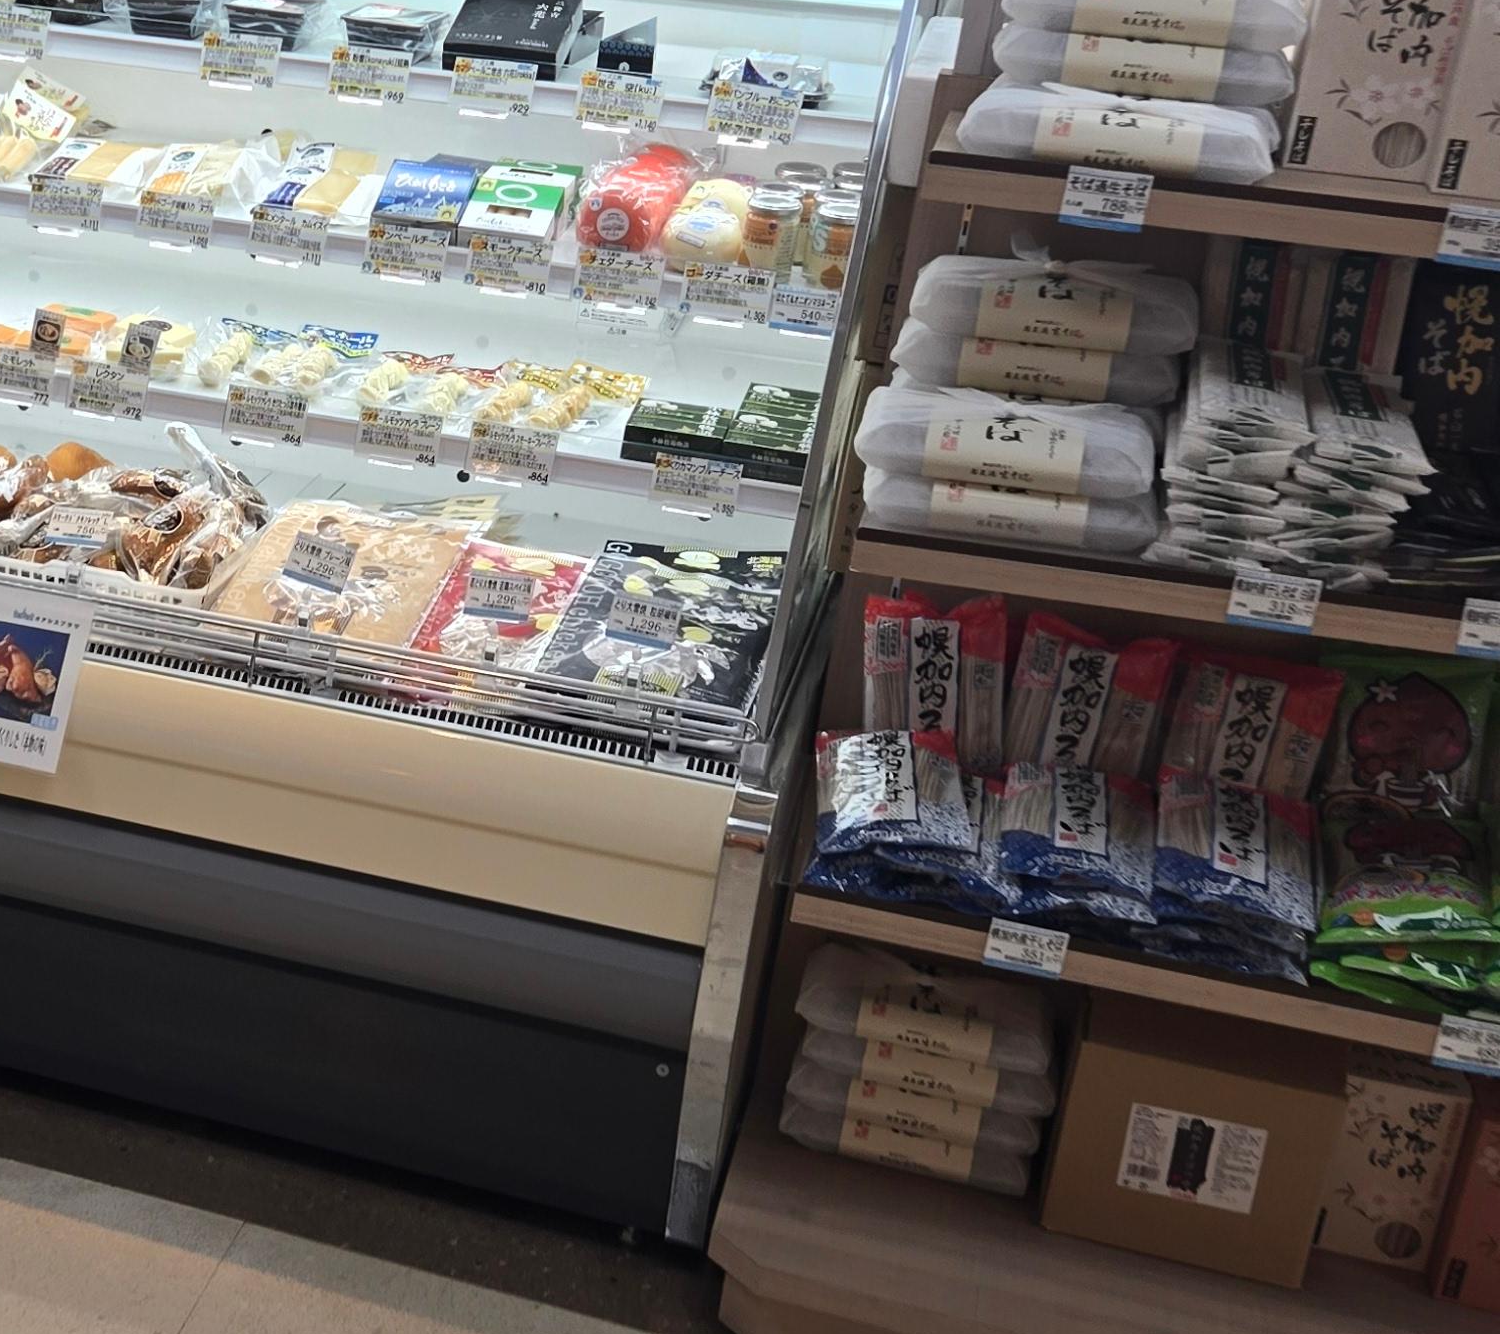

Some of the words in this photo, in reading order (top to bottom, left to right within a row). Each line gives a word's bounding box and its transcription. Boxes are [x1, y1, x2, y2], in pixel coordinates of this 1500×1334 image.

[1101, 197, 1127, 213] 788
[369, 228, 447, 247] カマンベールチーズ
[480, 242, 543, 257] スモークチーズ
[588, 255, 653, 271] チェダーチーズ
[1443, 284, 1495, 396] 幌加内
[1, 357, 36, 369] ミモレット
[305, 557, 334, 577] 1,296
[485, 592, 518, 606] 1,296
[629, 618, 661, 633] 1,296
[914, 626, 956, 731] 幌加内そ
[1054, 651, 1107, 765] 幌加内そ
[1218, 683, 1277, 782] 幌加内
